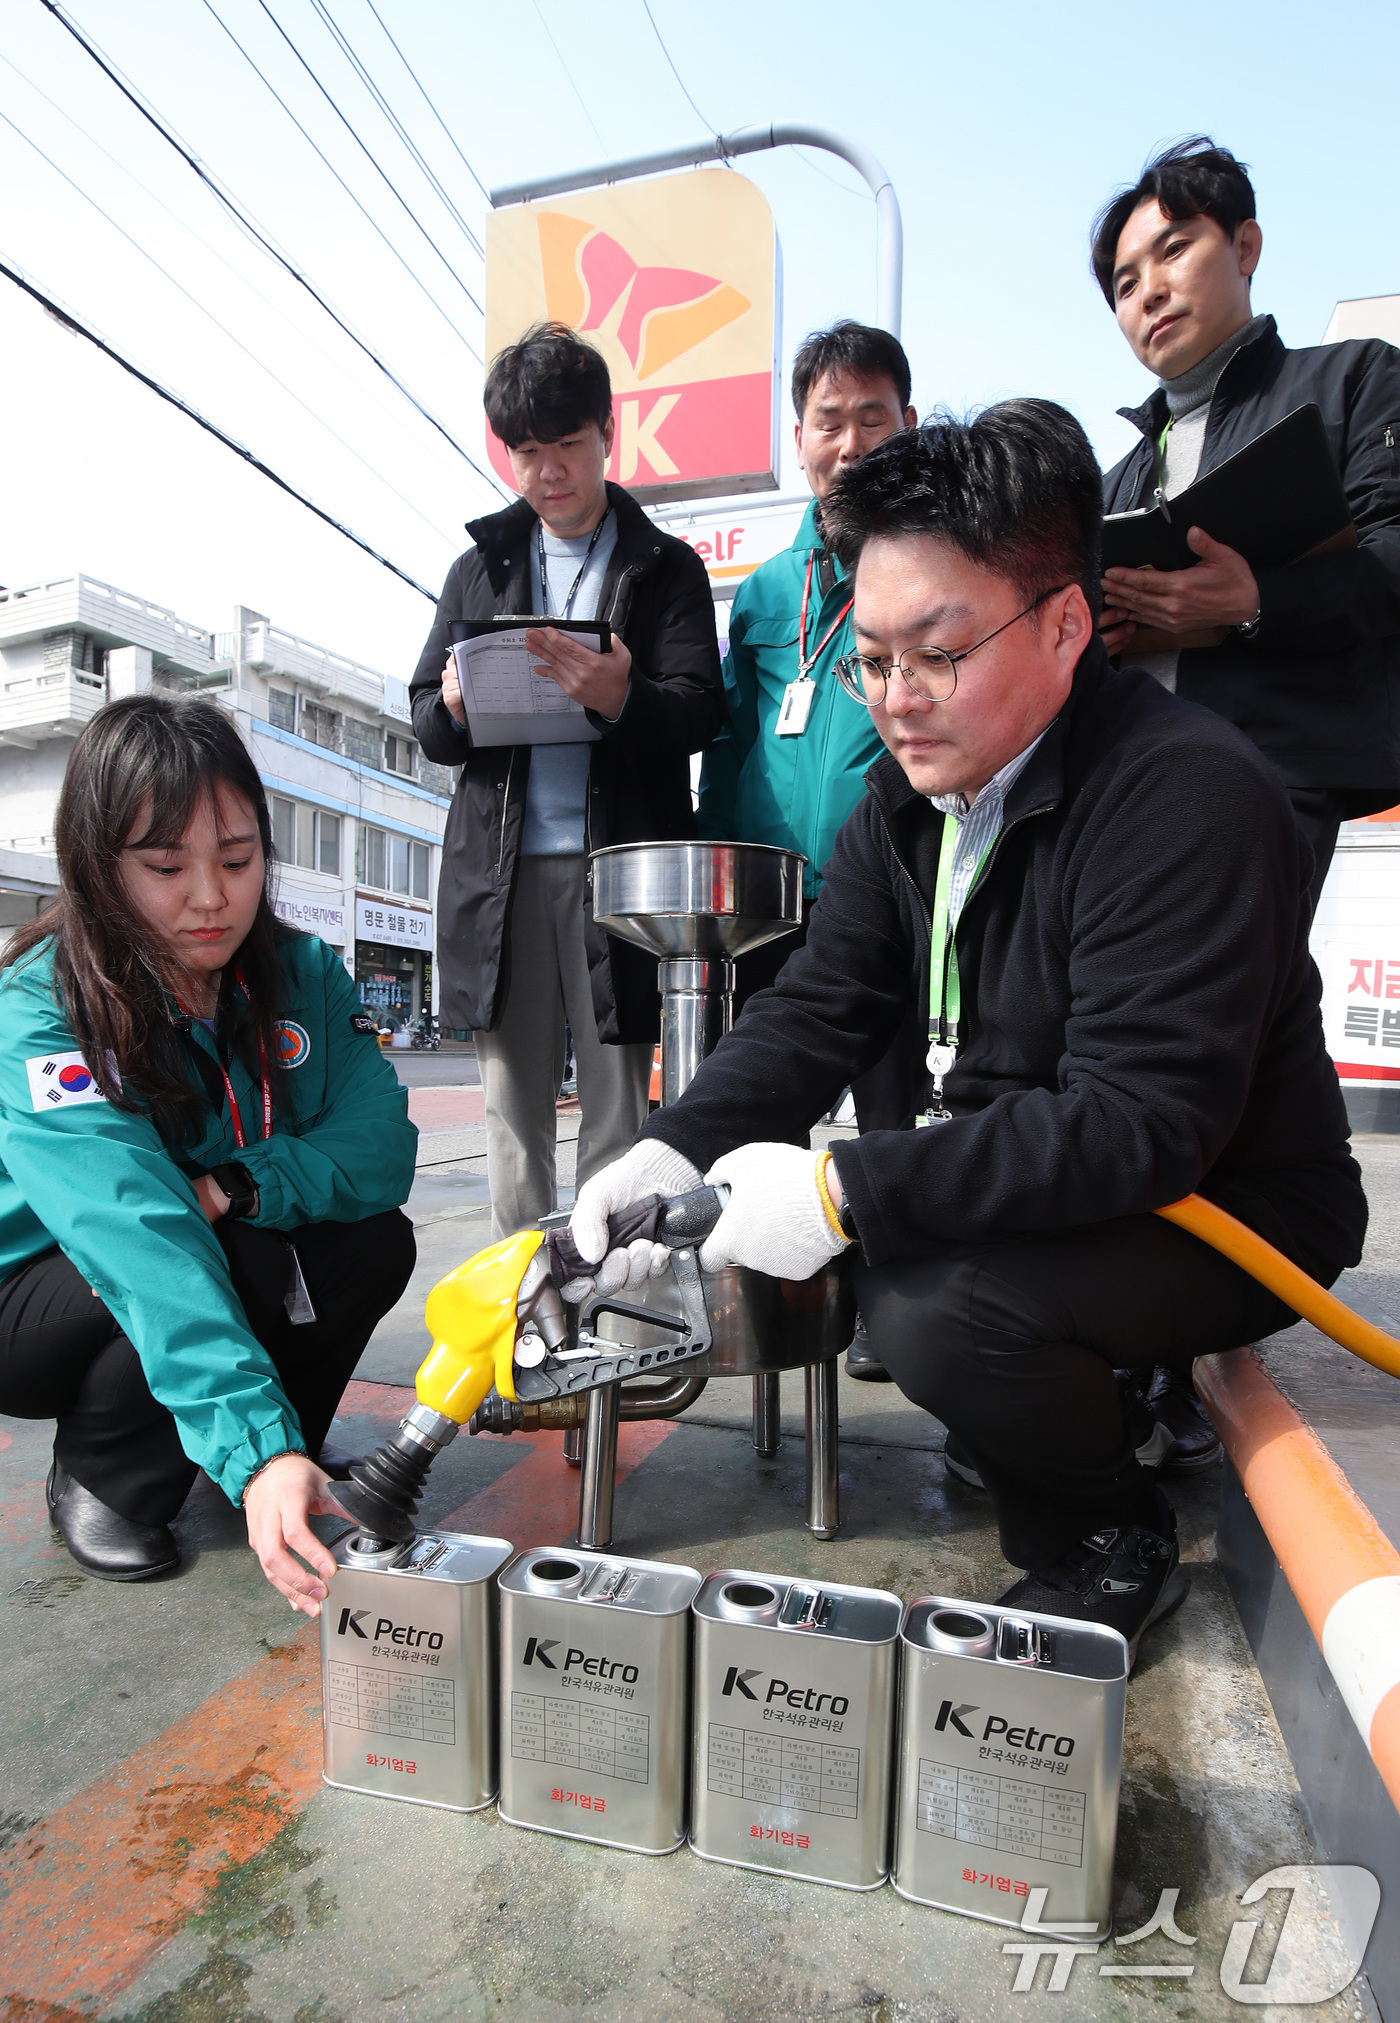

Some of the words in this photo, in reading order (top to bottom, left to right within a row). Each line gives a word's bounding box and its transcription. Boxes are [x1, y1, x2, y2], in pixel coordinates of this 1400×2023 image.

[604, 393, 682, 482] K
[678, 527, 745, 563] elf
[364, 909, 384, 928] 명문
[387, 913, 406, 933] 철물
[409, 918, 427, 937] 전기
[337, 1608, 372, 1639] K
[374, 1618, 444, 1650] Petro
[371, 1645, 440, 1666] 한국석유관리원
[523, 1637, 561, 1670] K
[564, 1648, 639, 1684] Petro
[561, 1675, 635, 1700] 한국석유관리원
[721, 1667, 763, 1701] K
[766, 1679, 849, 1715] Petro
[762, 1708, 844, 1733] 한국석유관리원
[934, 1700, 981, 1738] K
[983, 1716, 1075, 1757] Petro
[366, 1753, 418, 1774] 화기엄금
[978, 1745, 1069, 1776] 한국석유관리원
[551, 1787, 606, 1813] 화기엄금
[750, 1825, 811, 1849] 화기엄금
[961, 1868, 1029, 1897] 화기엄금
